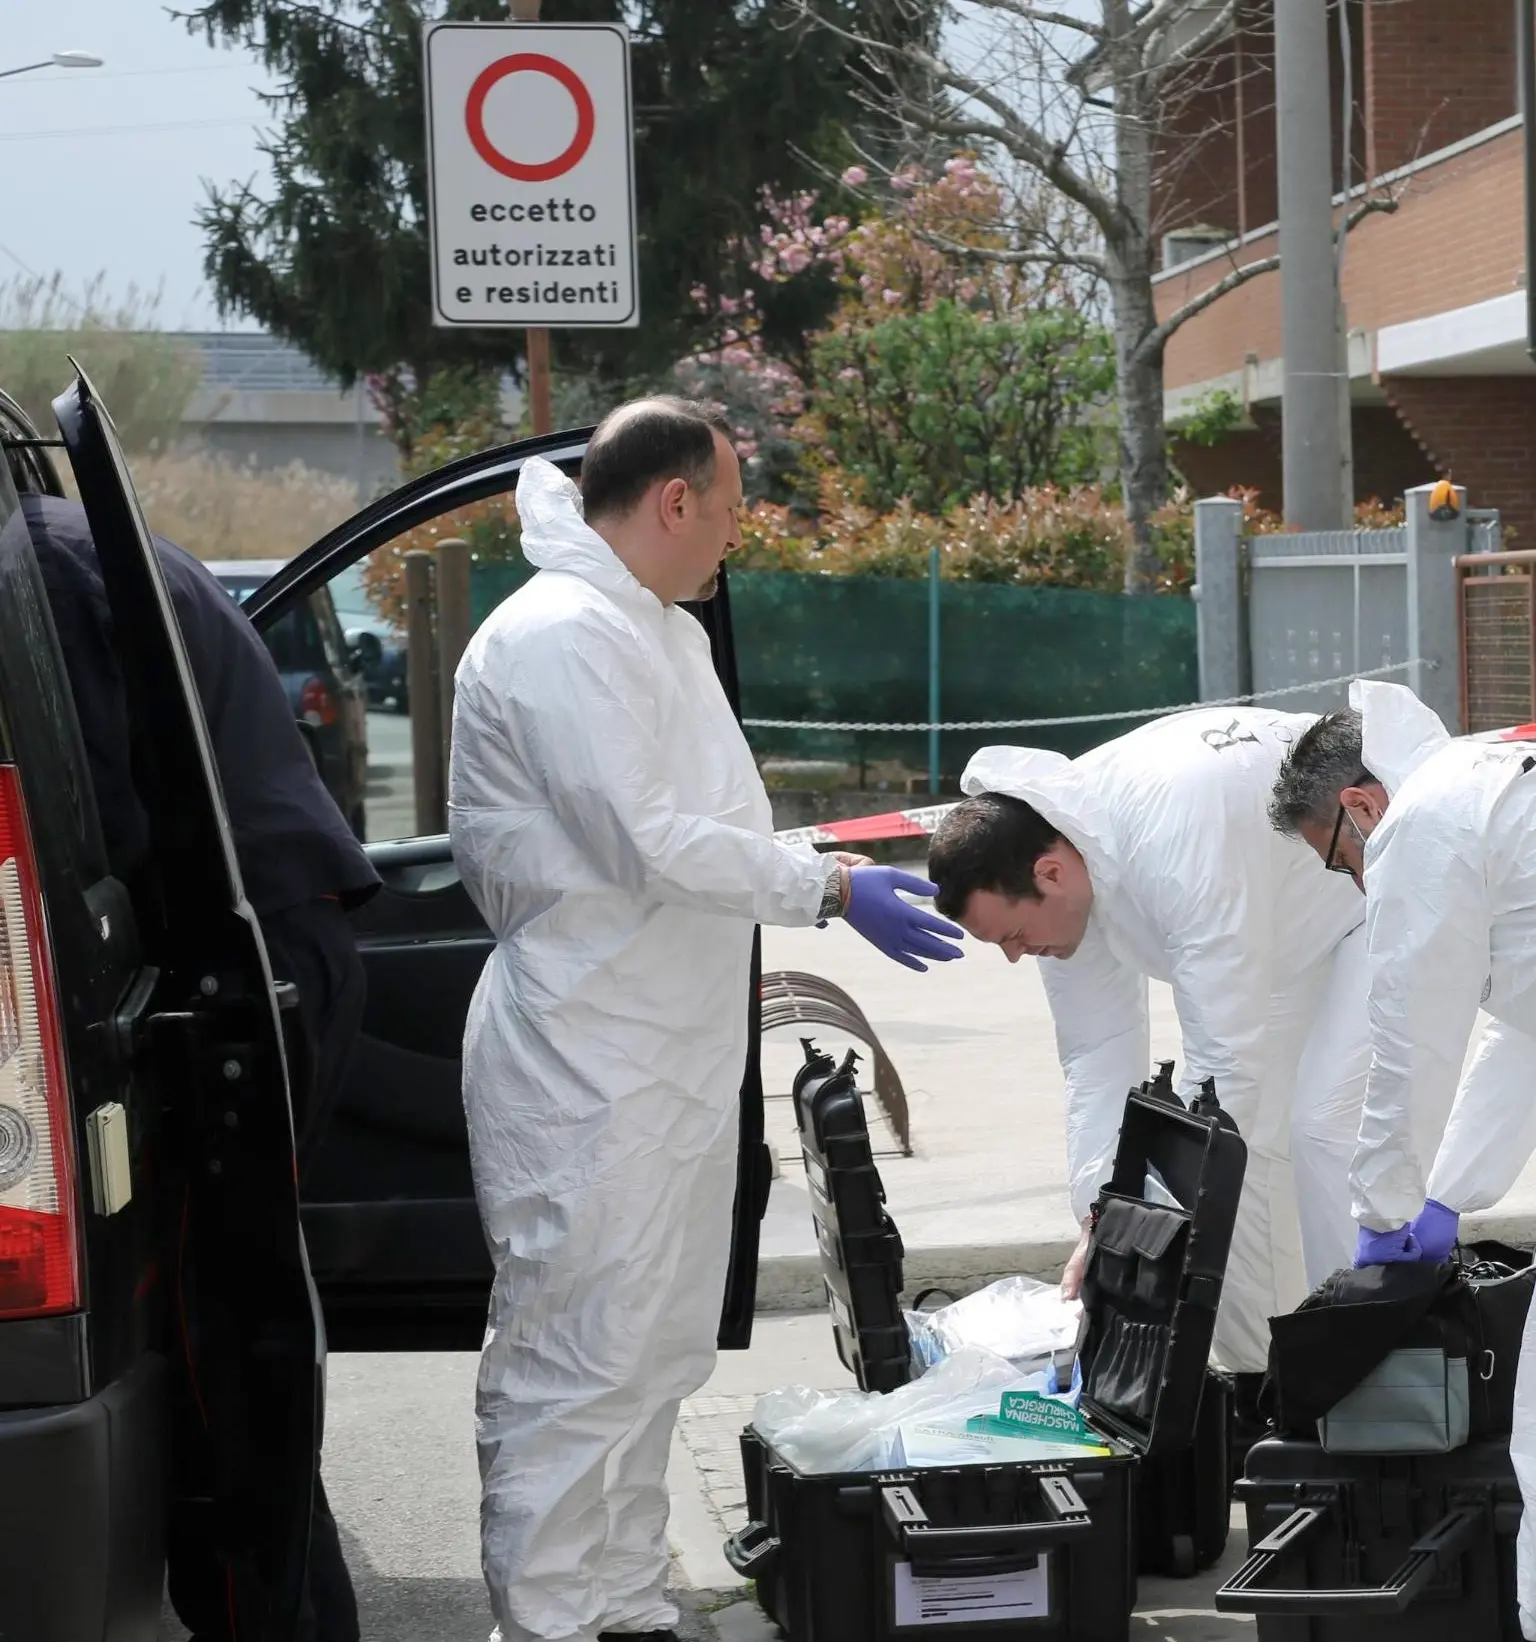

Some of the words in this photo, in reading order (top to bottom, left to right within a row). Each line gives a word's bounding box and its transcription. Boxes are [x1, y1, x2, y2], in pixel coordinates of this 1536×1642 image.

[470, 198, 597, 222] eccetto
[453, 244, 616, 267] autorizzati
[456, 286, 472, 303] e
[486, 281, 619, 304] residenti
[1005, 1408, 1080, 1432] MASCHERINA
[1009, 1396, 1076, 1421] CHIRURGICA
